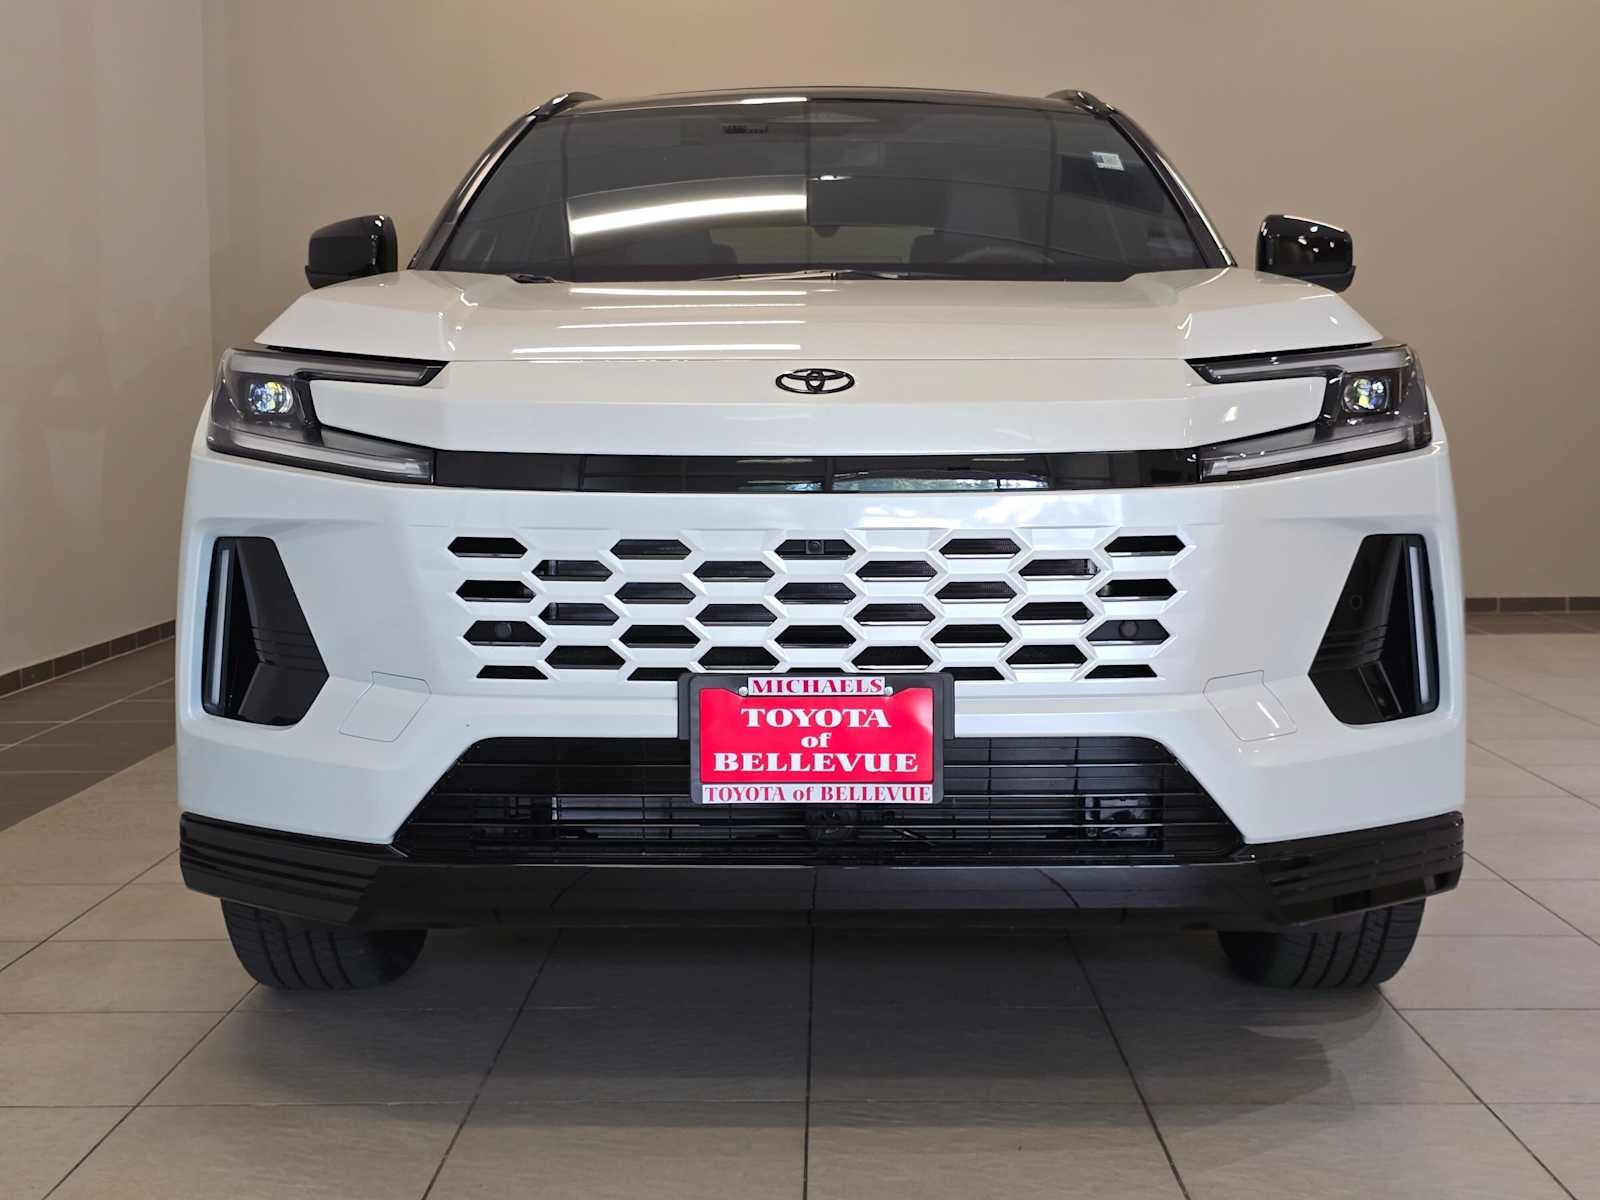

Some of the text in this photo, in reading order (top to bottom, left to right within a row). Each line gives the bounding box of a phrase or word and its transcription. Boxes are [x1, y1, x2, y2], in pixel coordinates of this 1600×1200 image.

[752, 678, 883, 694] MICHAELS
[740, 708, 891, 728] TOYOTA
[800, 732, 832, 748] of
[713, 752, 918, 772] BELLEVUE
[704, 785, 930, 801] TOYOTA of BELLEVUE
